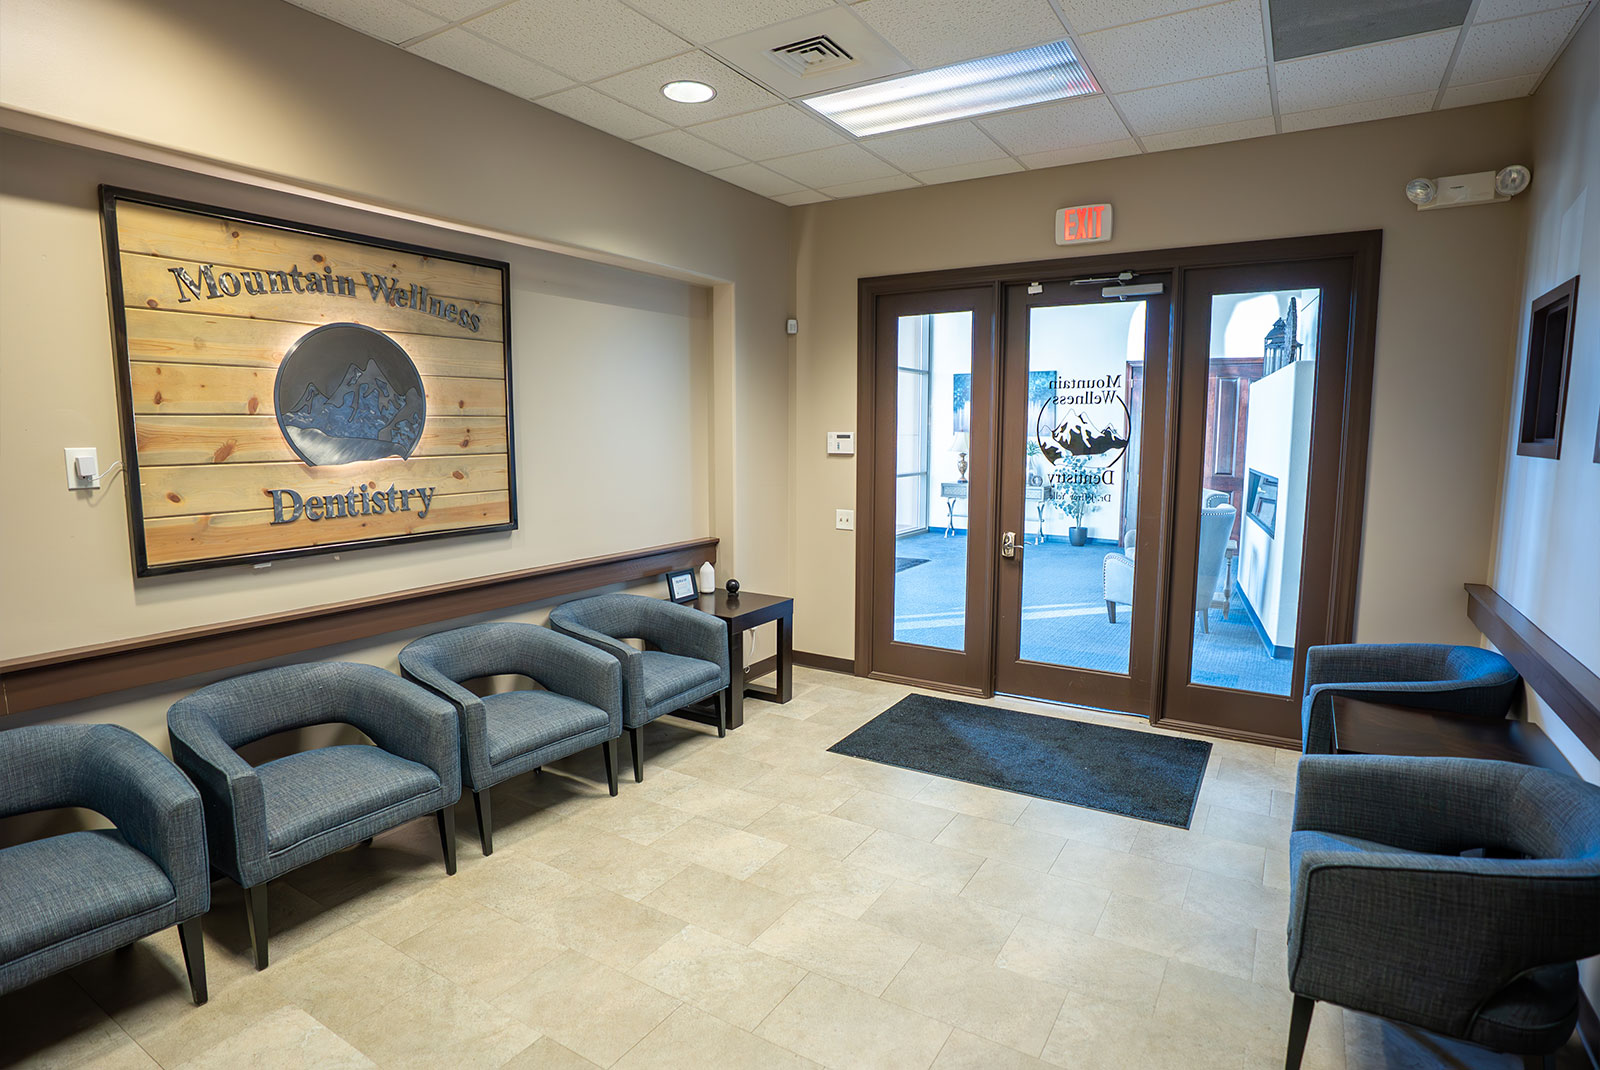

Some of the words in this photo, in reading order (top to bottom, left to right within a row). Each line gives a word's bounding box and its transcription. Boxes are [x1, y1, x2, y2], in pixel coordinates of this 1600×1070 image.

[1064, 206, 1104, 240] EXIT
[168, 264, 356, 303] Mountain
[361, 271, 482, 333] Wellness
[268, 483, 436, 526] Dentistry
